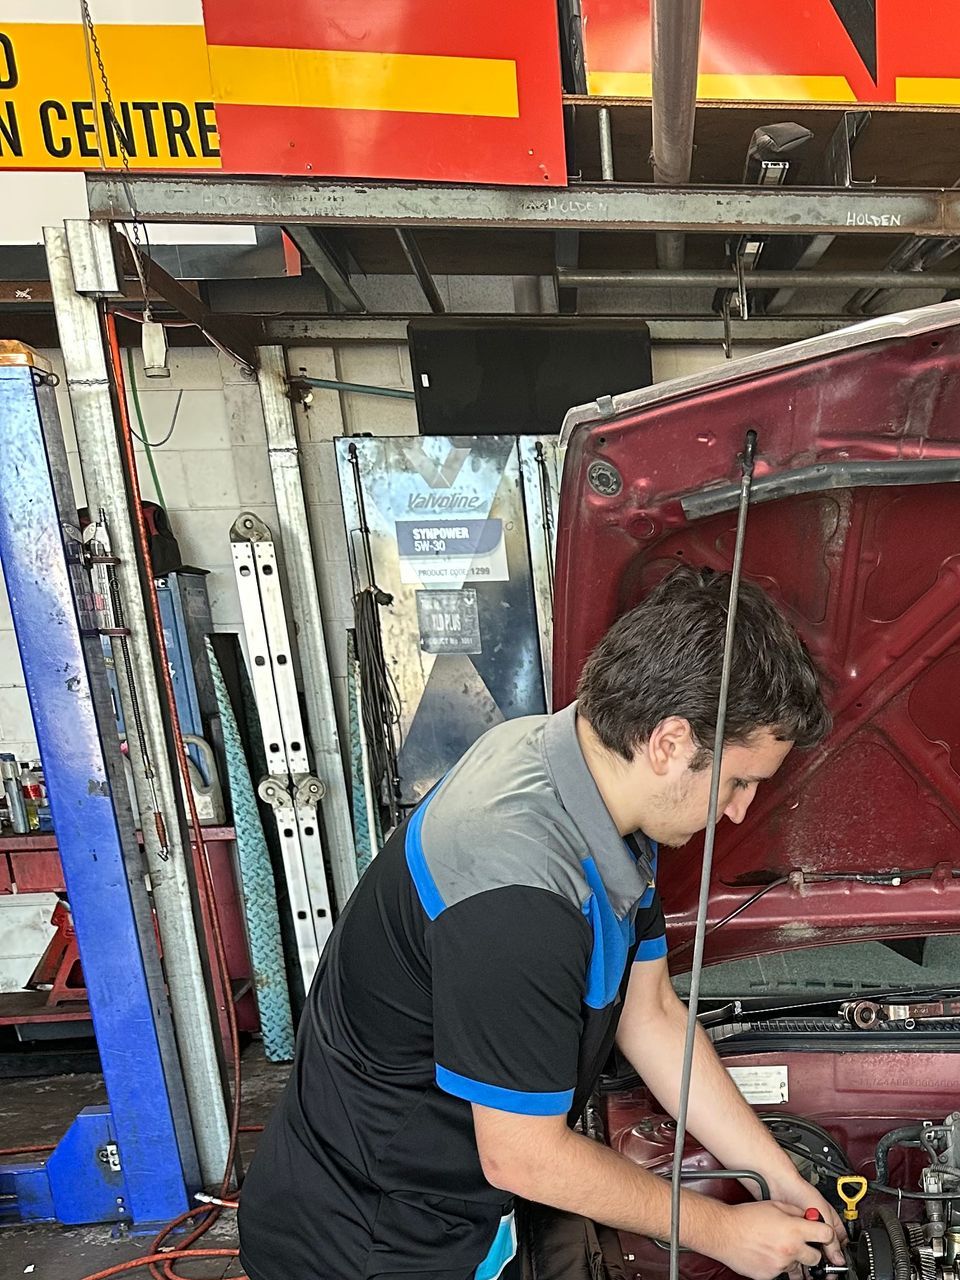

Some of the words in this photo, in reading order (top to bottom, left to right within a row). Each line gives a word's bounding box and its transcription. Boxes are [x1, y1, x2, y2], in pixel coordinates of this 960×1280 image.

[39, 100, 221, 158] CENTRE
[548, 198, 608, 213] HOLDEN
[846, 212, 901, 227] HOLDEN
[408, 493, 480, 509] Valvoline
[412, 527, 470, 540] SYNPOWER
[414, 540, 446, 552] 5W-30
